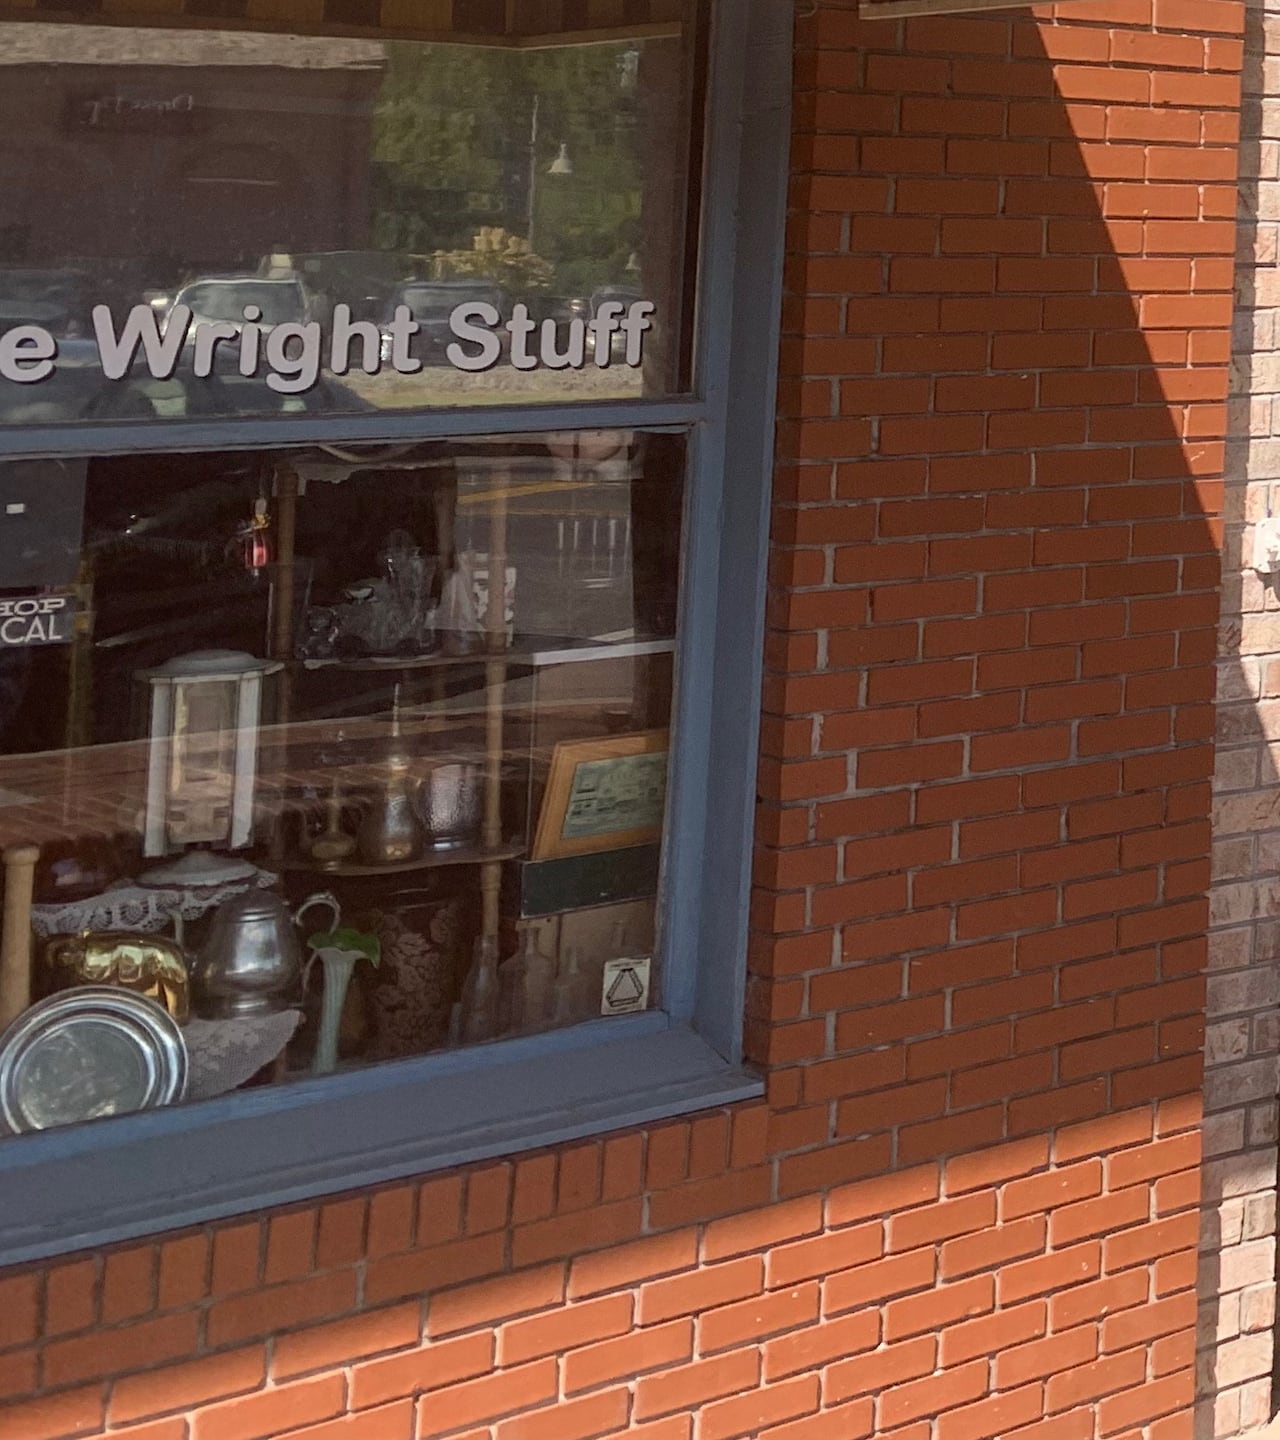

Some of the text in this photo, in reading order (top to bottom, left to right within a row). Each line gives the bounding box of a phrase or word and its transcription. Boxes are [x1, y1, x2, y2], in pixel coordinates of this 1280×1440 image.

[92, 304, 420, 392] Wright
[446, 301, 655, 371] Stuff
[0, 598, 66, 616] HOP
[0, 615, 62, 643] CAL
